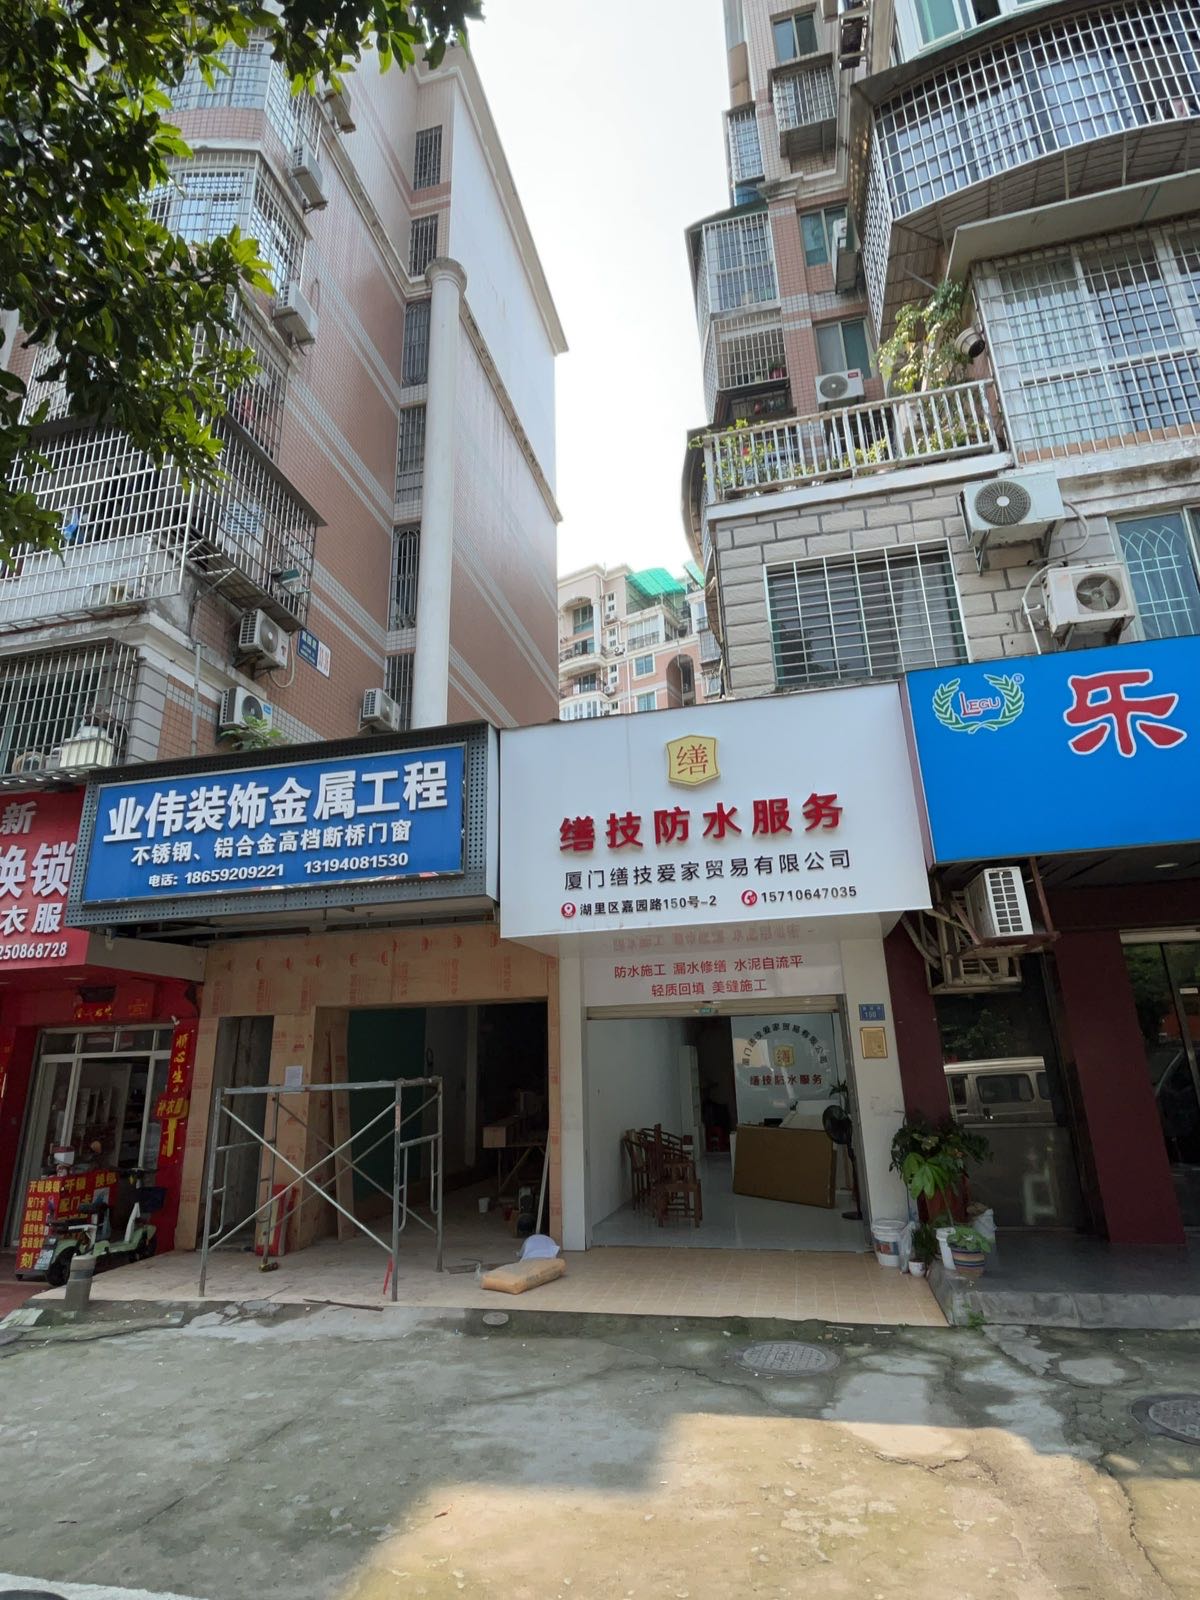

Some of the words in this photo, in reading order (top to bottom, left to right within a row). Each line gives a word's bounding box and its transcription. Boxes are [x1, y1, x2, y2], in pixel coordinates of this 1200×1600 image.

[958, 691, 1001, 718] LEGU
[1062, 668, 1188, 758] 乐
[676, 743, 710, 776] 缮
[103, 760, 448, 843] 业伟装饰金属工程
[559, 792, 845, 853] 缮技防水服务
[131, 818, 413, 867] 不锈钢、铝合金高档断桥门窗
[304, 852, 409, 875] 13194081530
[564, 848, 851, 891] 厦门缮技爱家贸易有限公司
[579, 893, 718, 917] 湖里区嘉园路150号-2
[760, 885, 858, 903] 15710647035
[614, 963, 667, 979] 防水施工
[673, 960, 728, 976] 漏水修缮
[734, 954, 804, 973] 水泥自流平
[651, 982, 705, 998] 轻质回填
[712, 979, 768, 995] 美缝施工
